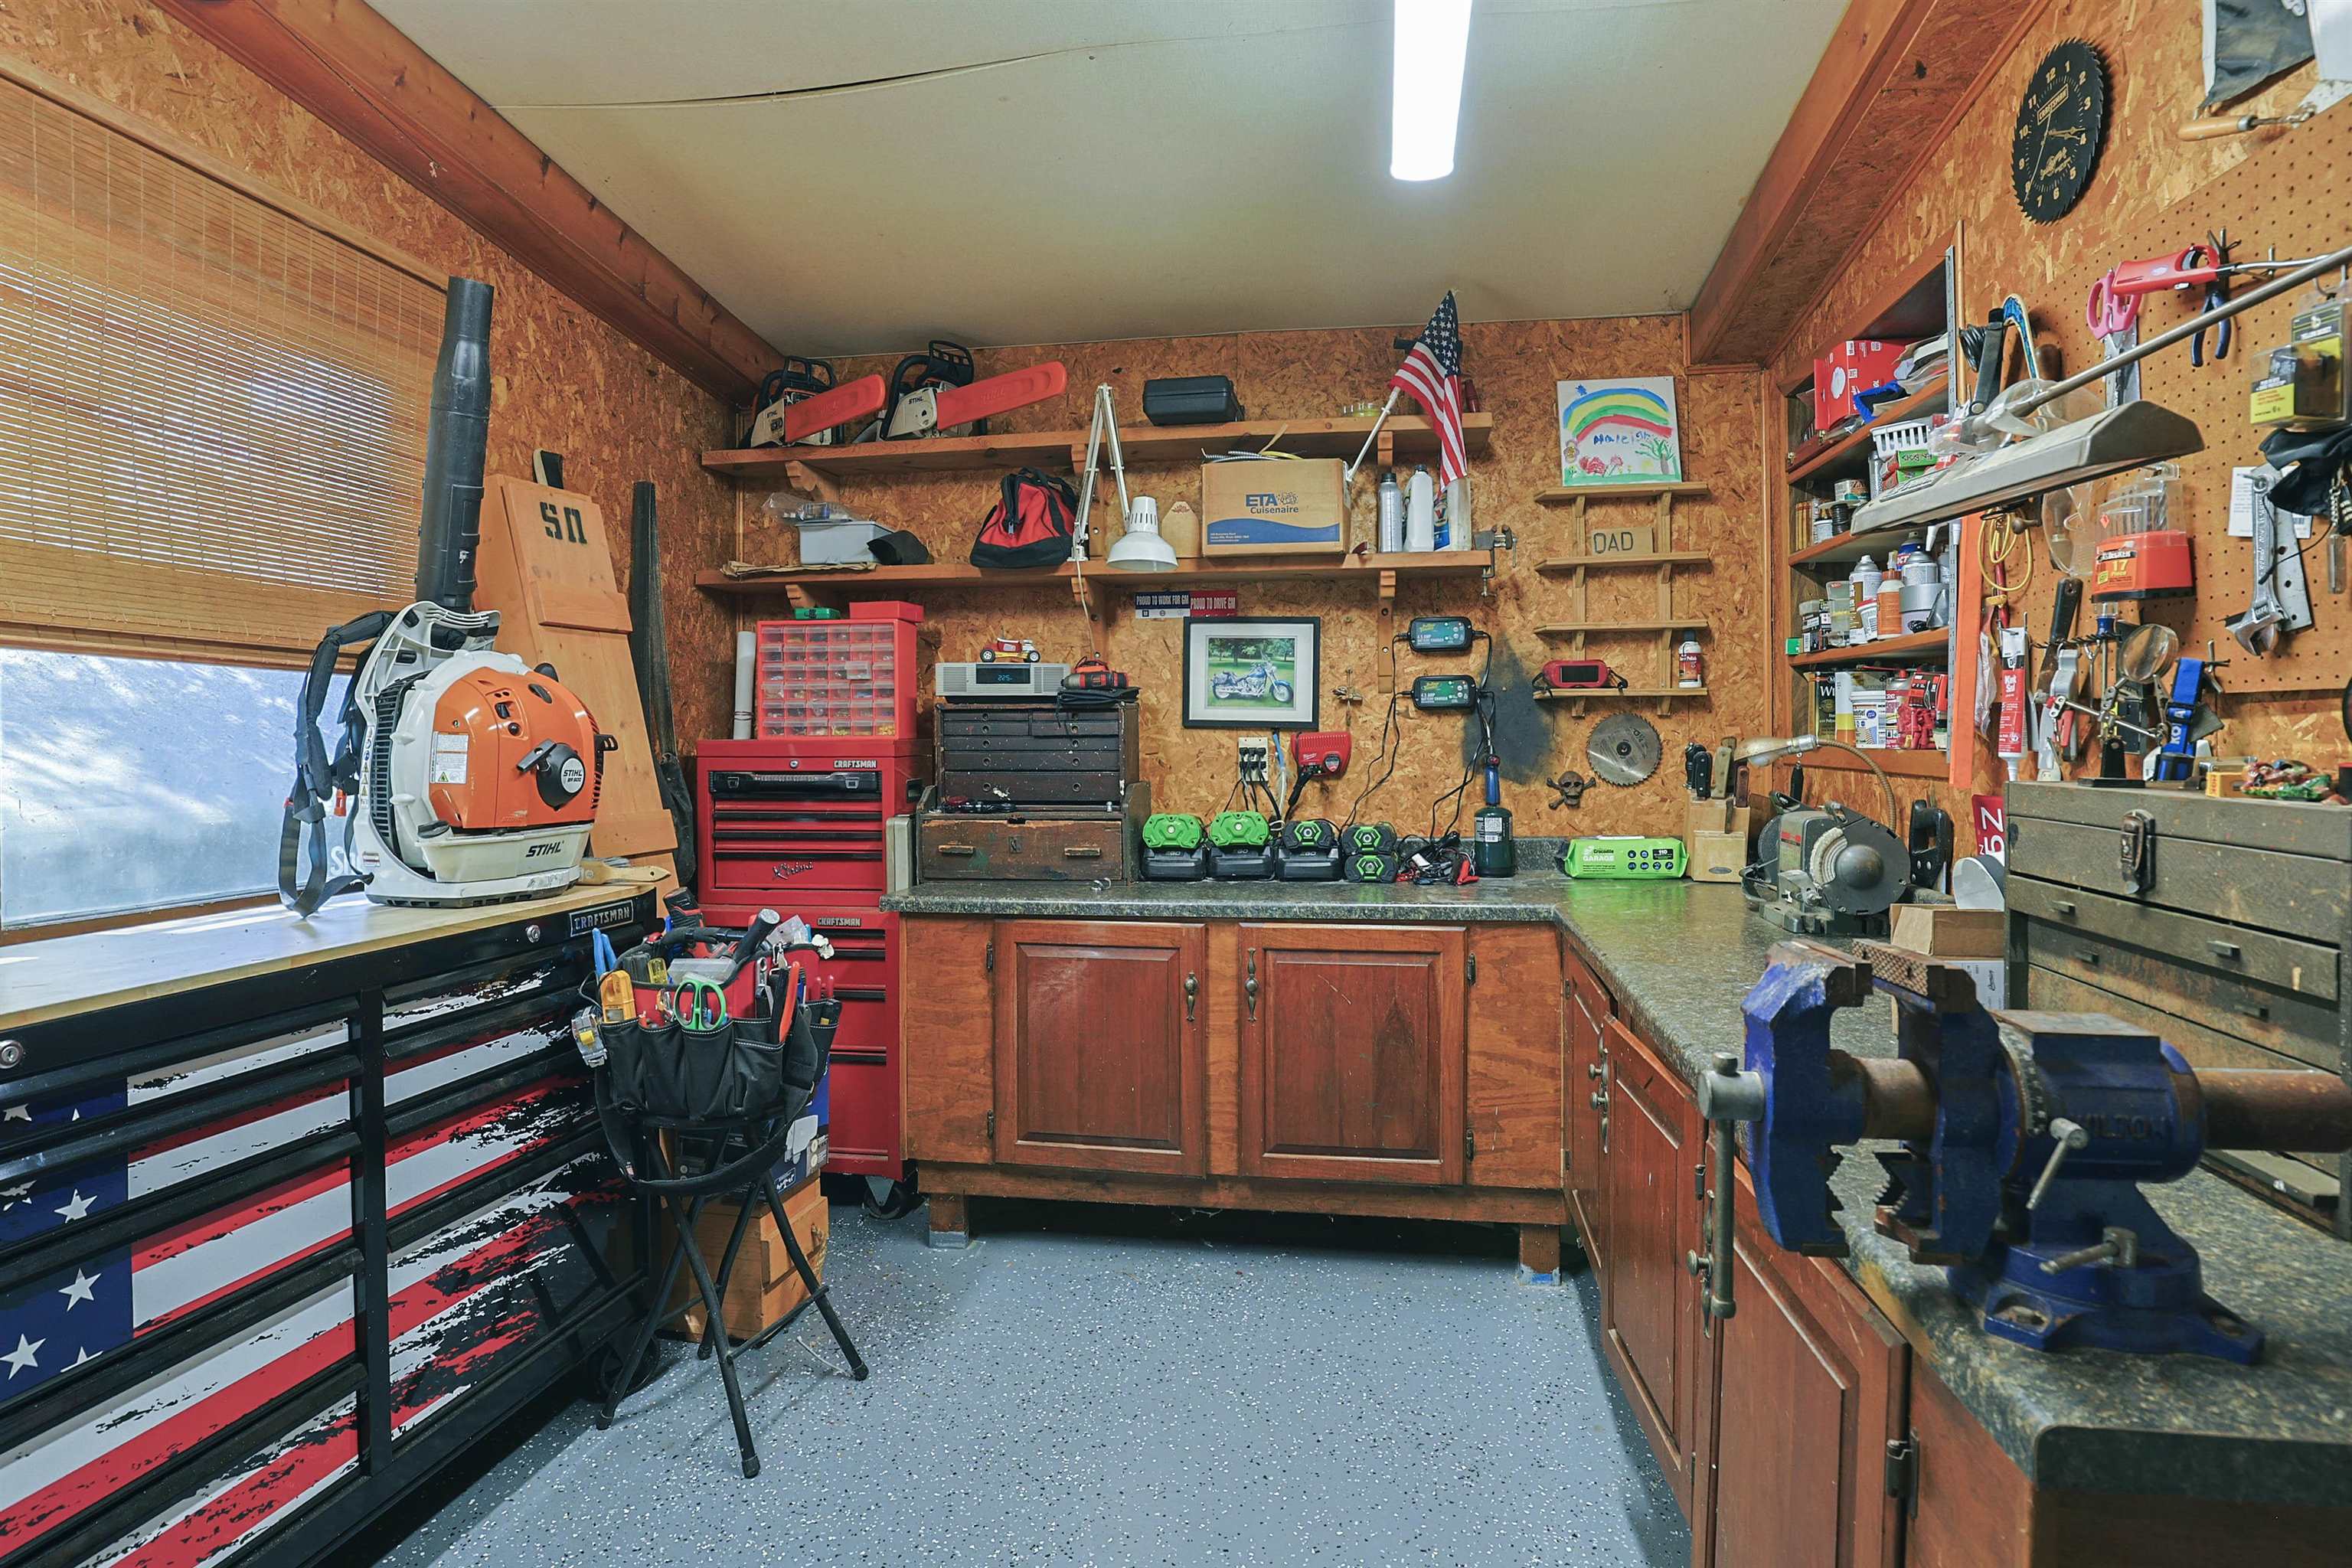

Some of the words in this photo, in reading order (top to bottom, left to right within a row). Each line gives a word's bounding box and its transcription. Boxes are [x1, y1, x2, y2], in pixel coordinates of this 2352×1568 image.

[2065, 60, 2070, 73] 1
[2046, 67, 2056, 83] 12
[2079, 70, 2086, 85] 2
[2028, 94, 2037, 109] 11
[2039, 89, 2068, 120] CRAFTSMAN
[2084, 96, 2092, 110] 3
[2019, 125, 2029, 139] 10
[2019, 158, 2025, 170] 9
[2069, 167, 2076, 180] 5
[2053, 187, 2060, 200] 6
[908, 396, 924, 405] STIHL
[1245, 493, 1278, 507] ETA
[1593, 531, 1634, 554] DAD
[2113, 560, 2129, 571] 17
[1136, 596, 1151, 606] PROUD
[1152, 596, 1158, 605] TO
[1158, 596, 1171, 605] WORK
[1172, 595, 1181, 605] FOR
[1181, 595, 1189, 604] GM
[1191, 598, 1205, 609] PROUD
[1207, 598, 1213, 609] TO
[1214, 597, 1227, 609] DRIVE
[1227, 597, 1236, 609] GM
[525, 841, 562, 858] STIHL
[574, 906, 630, 930] CRAFTSMAN
[818, 917, 861, 926] CRAFTSMAN
